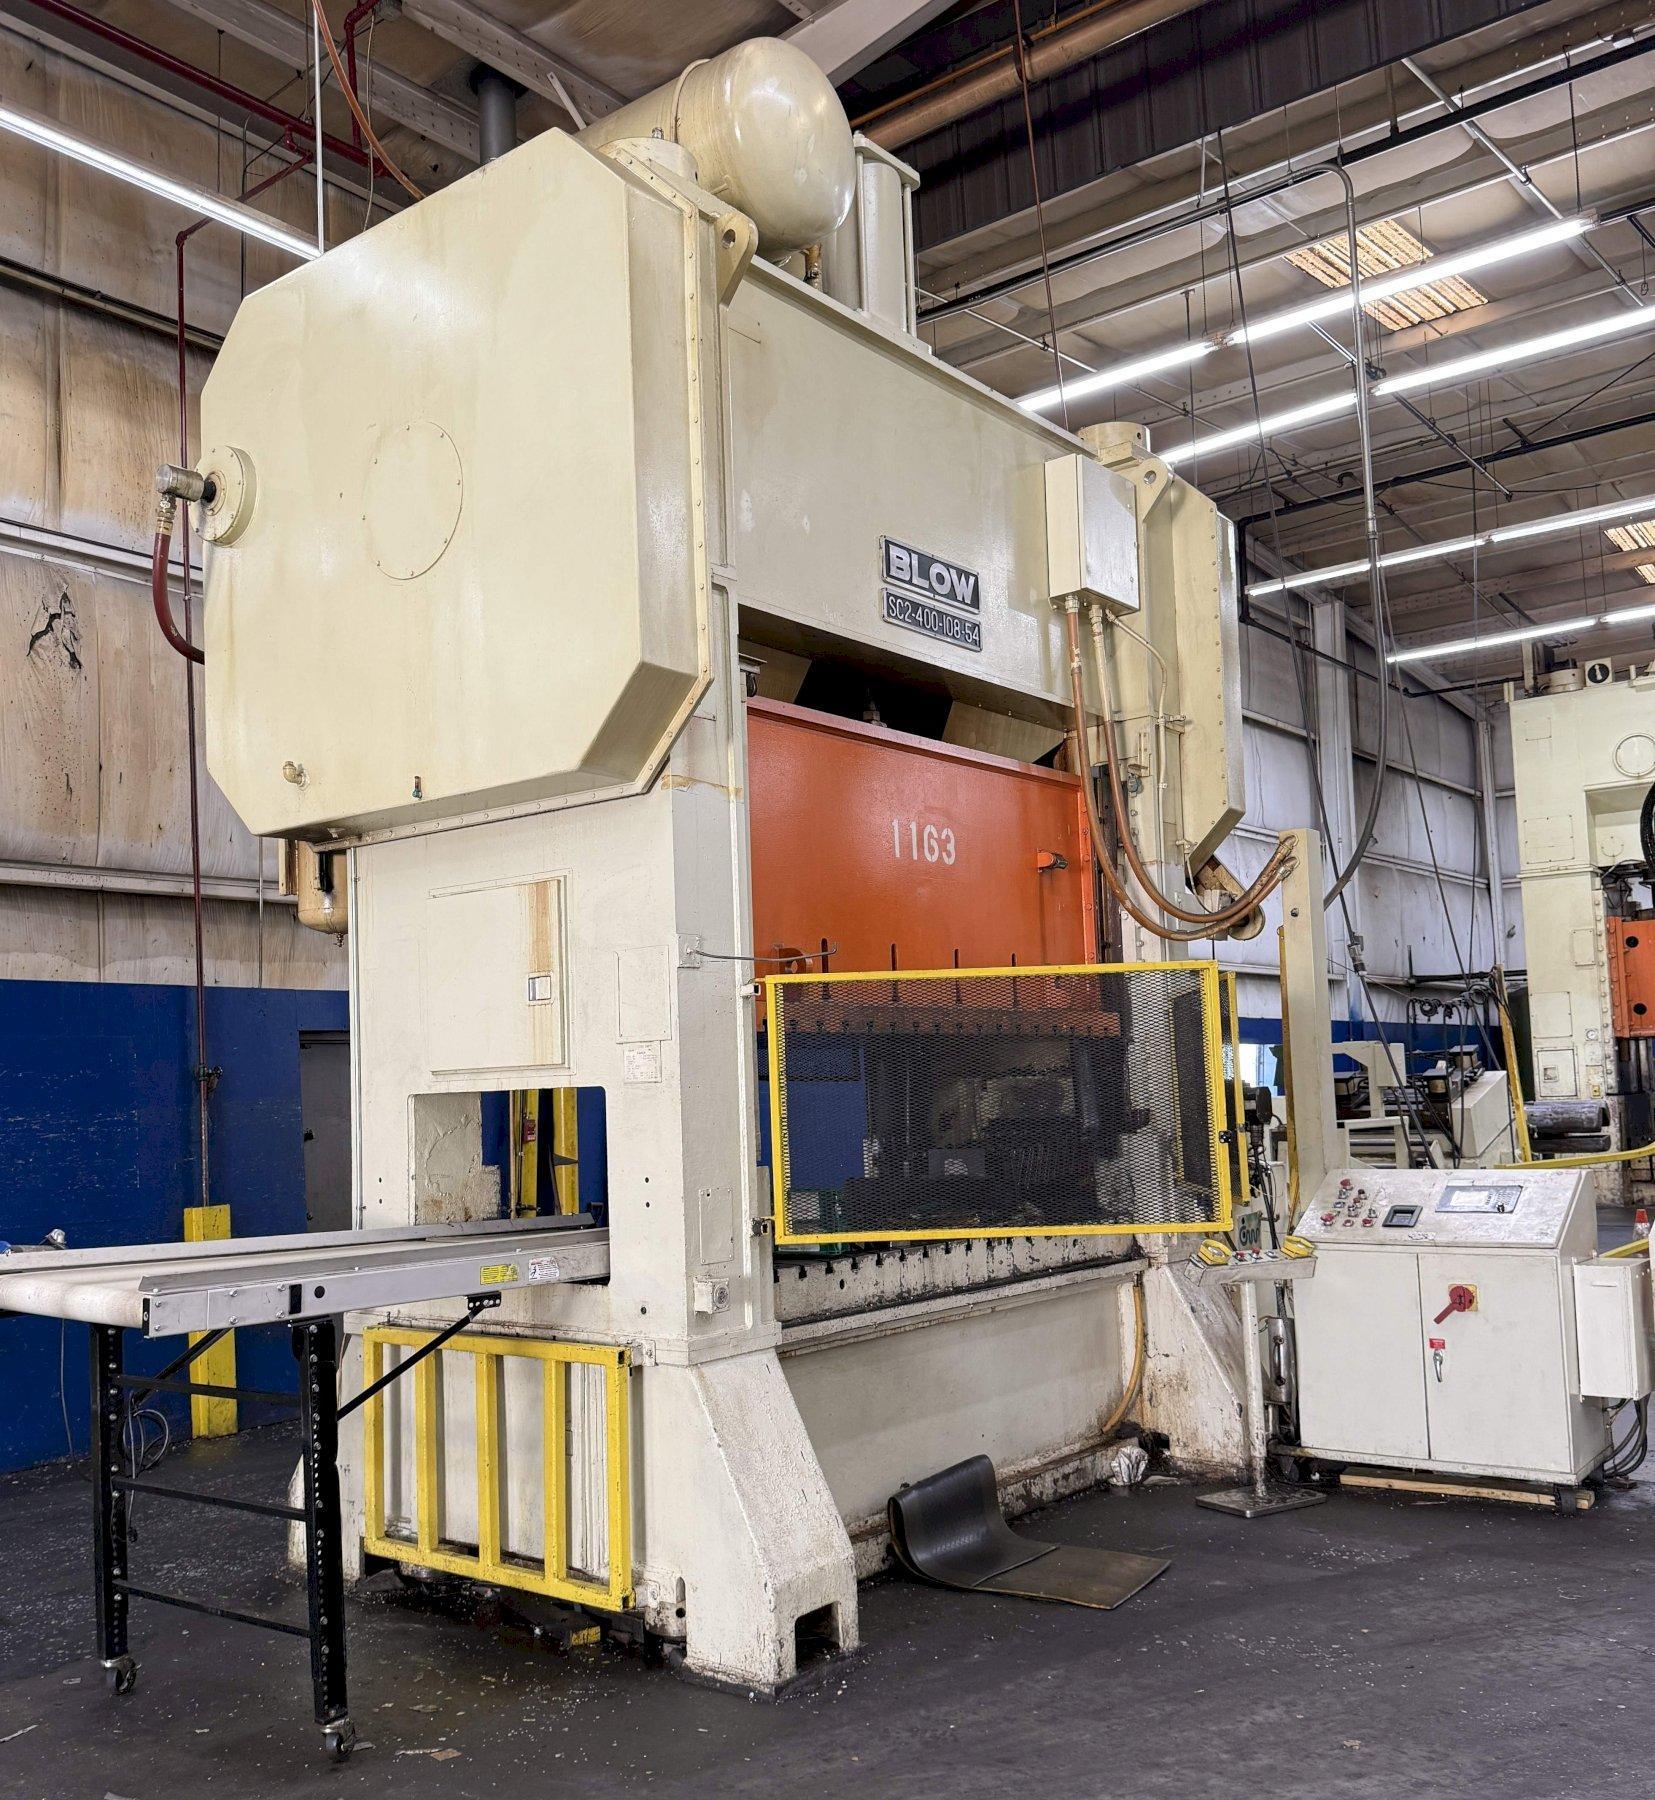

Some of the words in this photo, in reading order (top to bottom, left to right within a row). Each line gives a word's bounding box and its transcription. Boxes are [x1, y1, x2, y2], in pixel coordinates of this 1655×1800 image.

[889, 543, 976, 604] BLOW
[888, 596, 980, 647] SC2-400-108-54
[892, 819, 956, 866] 1163
